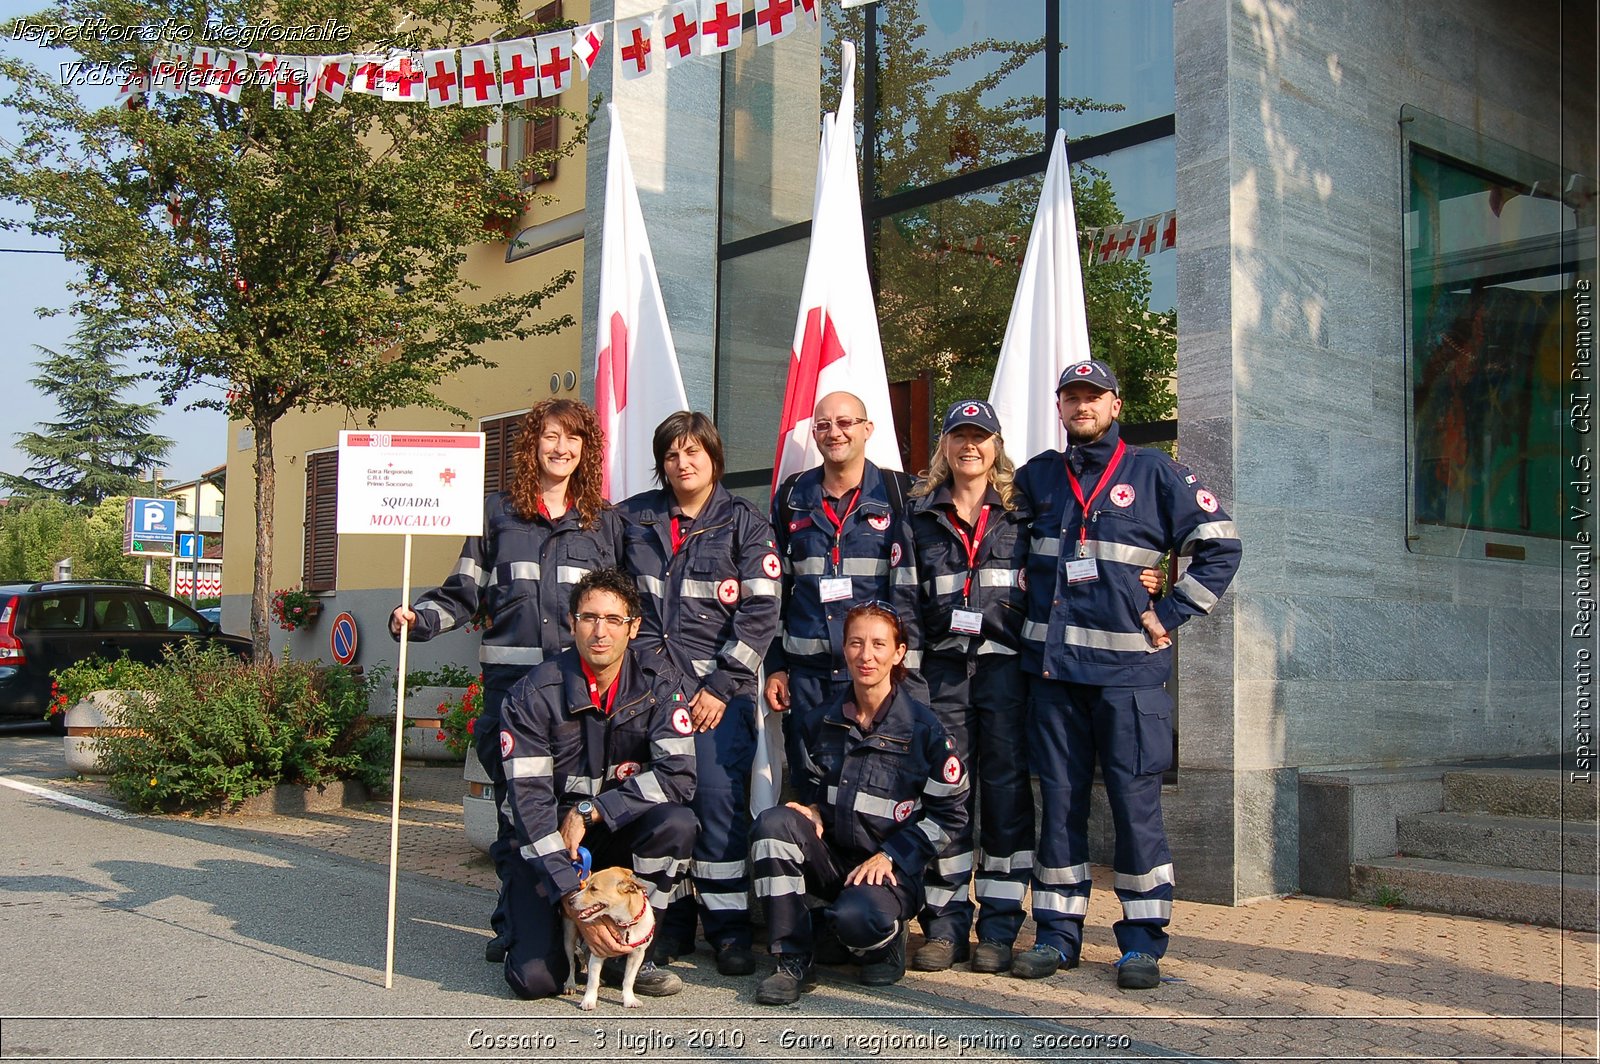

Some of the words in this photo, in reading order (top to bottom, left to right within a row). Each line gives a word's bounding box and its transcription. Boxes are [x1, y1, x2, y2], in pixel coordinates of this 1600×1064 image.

[381, 497, 440, 509] SQUADRA
[144, 508, 164, 531] P
[369, 514, 451, 527] MONCALVO
